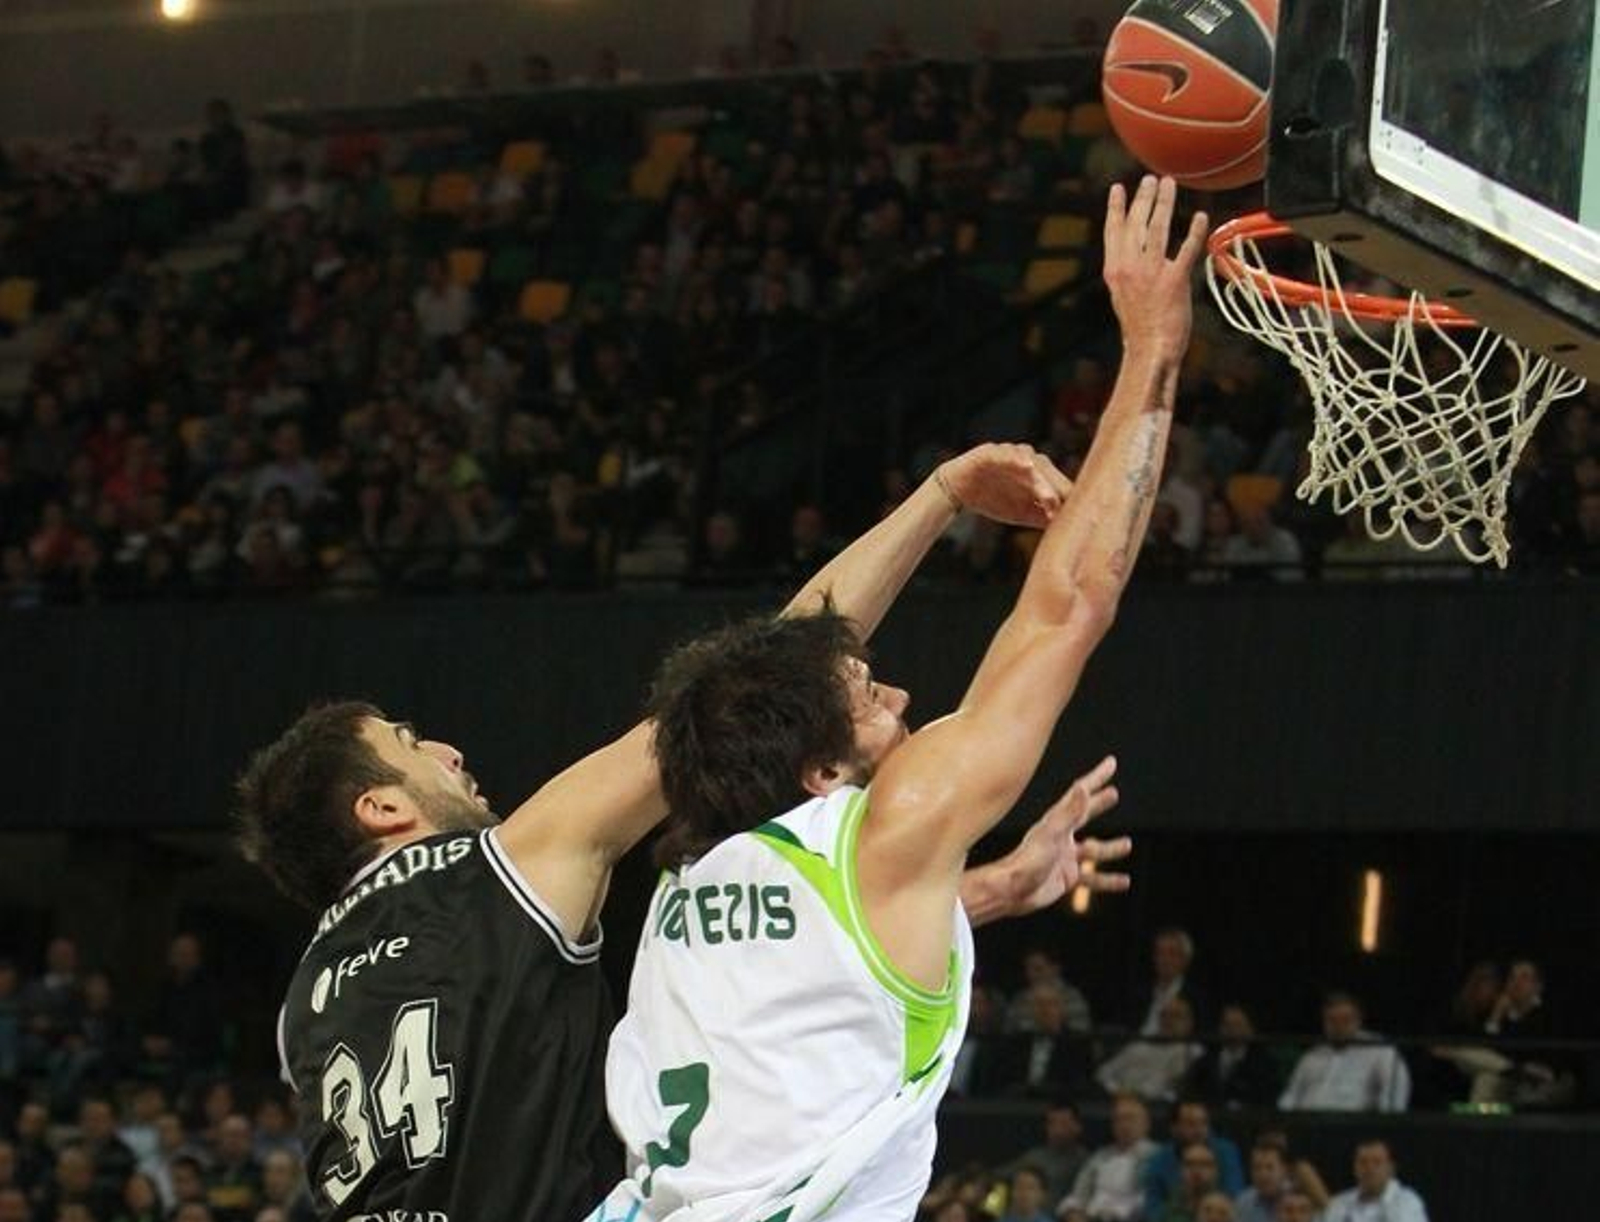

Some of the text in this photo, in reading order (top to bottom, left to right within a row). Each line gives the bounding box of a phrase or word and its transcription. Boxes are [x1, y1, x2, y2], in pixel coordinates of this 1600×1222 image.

[333, 935, 411, 999] feve
[320, 997, 456, 1207] 34
[641, 1062, 710, 1199] 7
